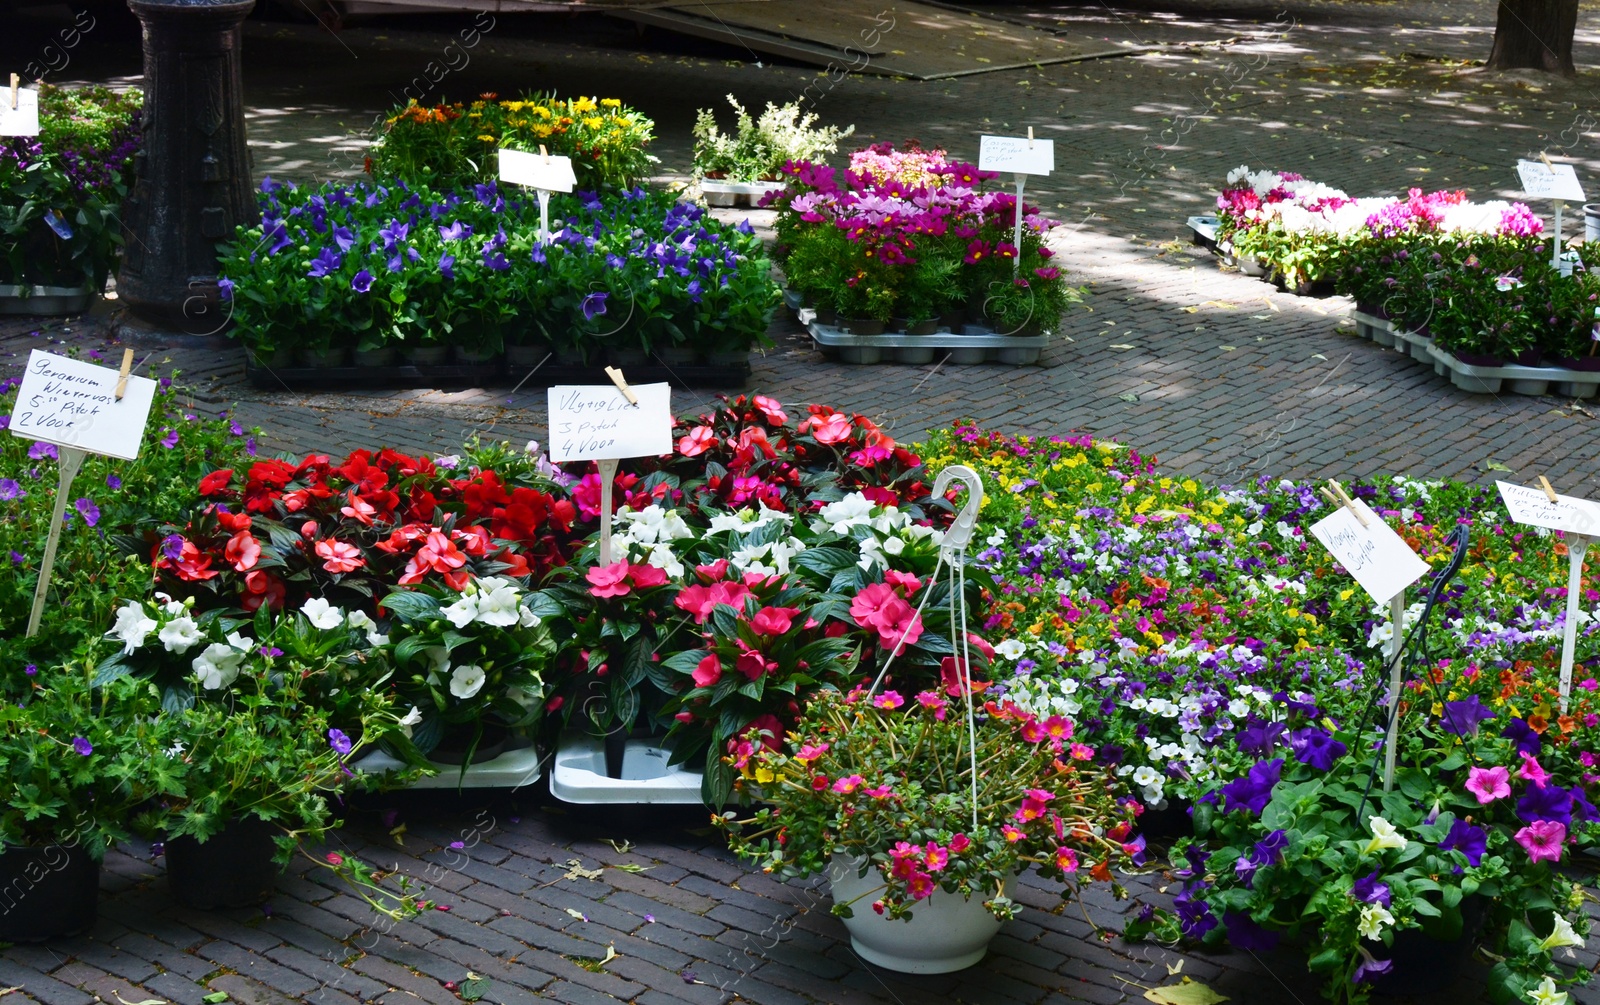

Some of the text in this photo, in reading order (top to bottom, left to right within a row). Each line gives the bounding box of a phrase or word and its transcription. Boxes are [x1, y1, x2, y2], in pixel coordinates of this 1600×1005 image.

[19, 411, 33, 427] 2
[559, 422, 572, 434] 3
[562, 438, 574, 457] 4
